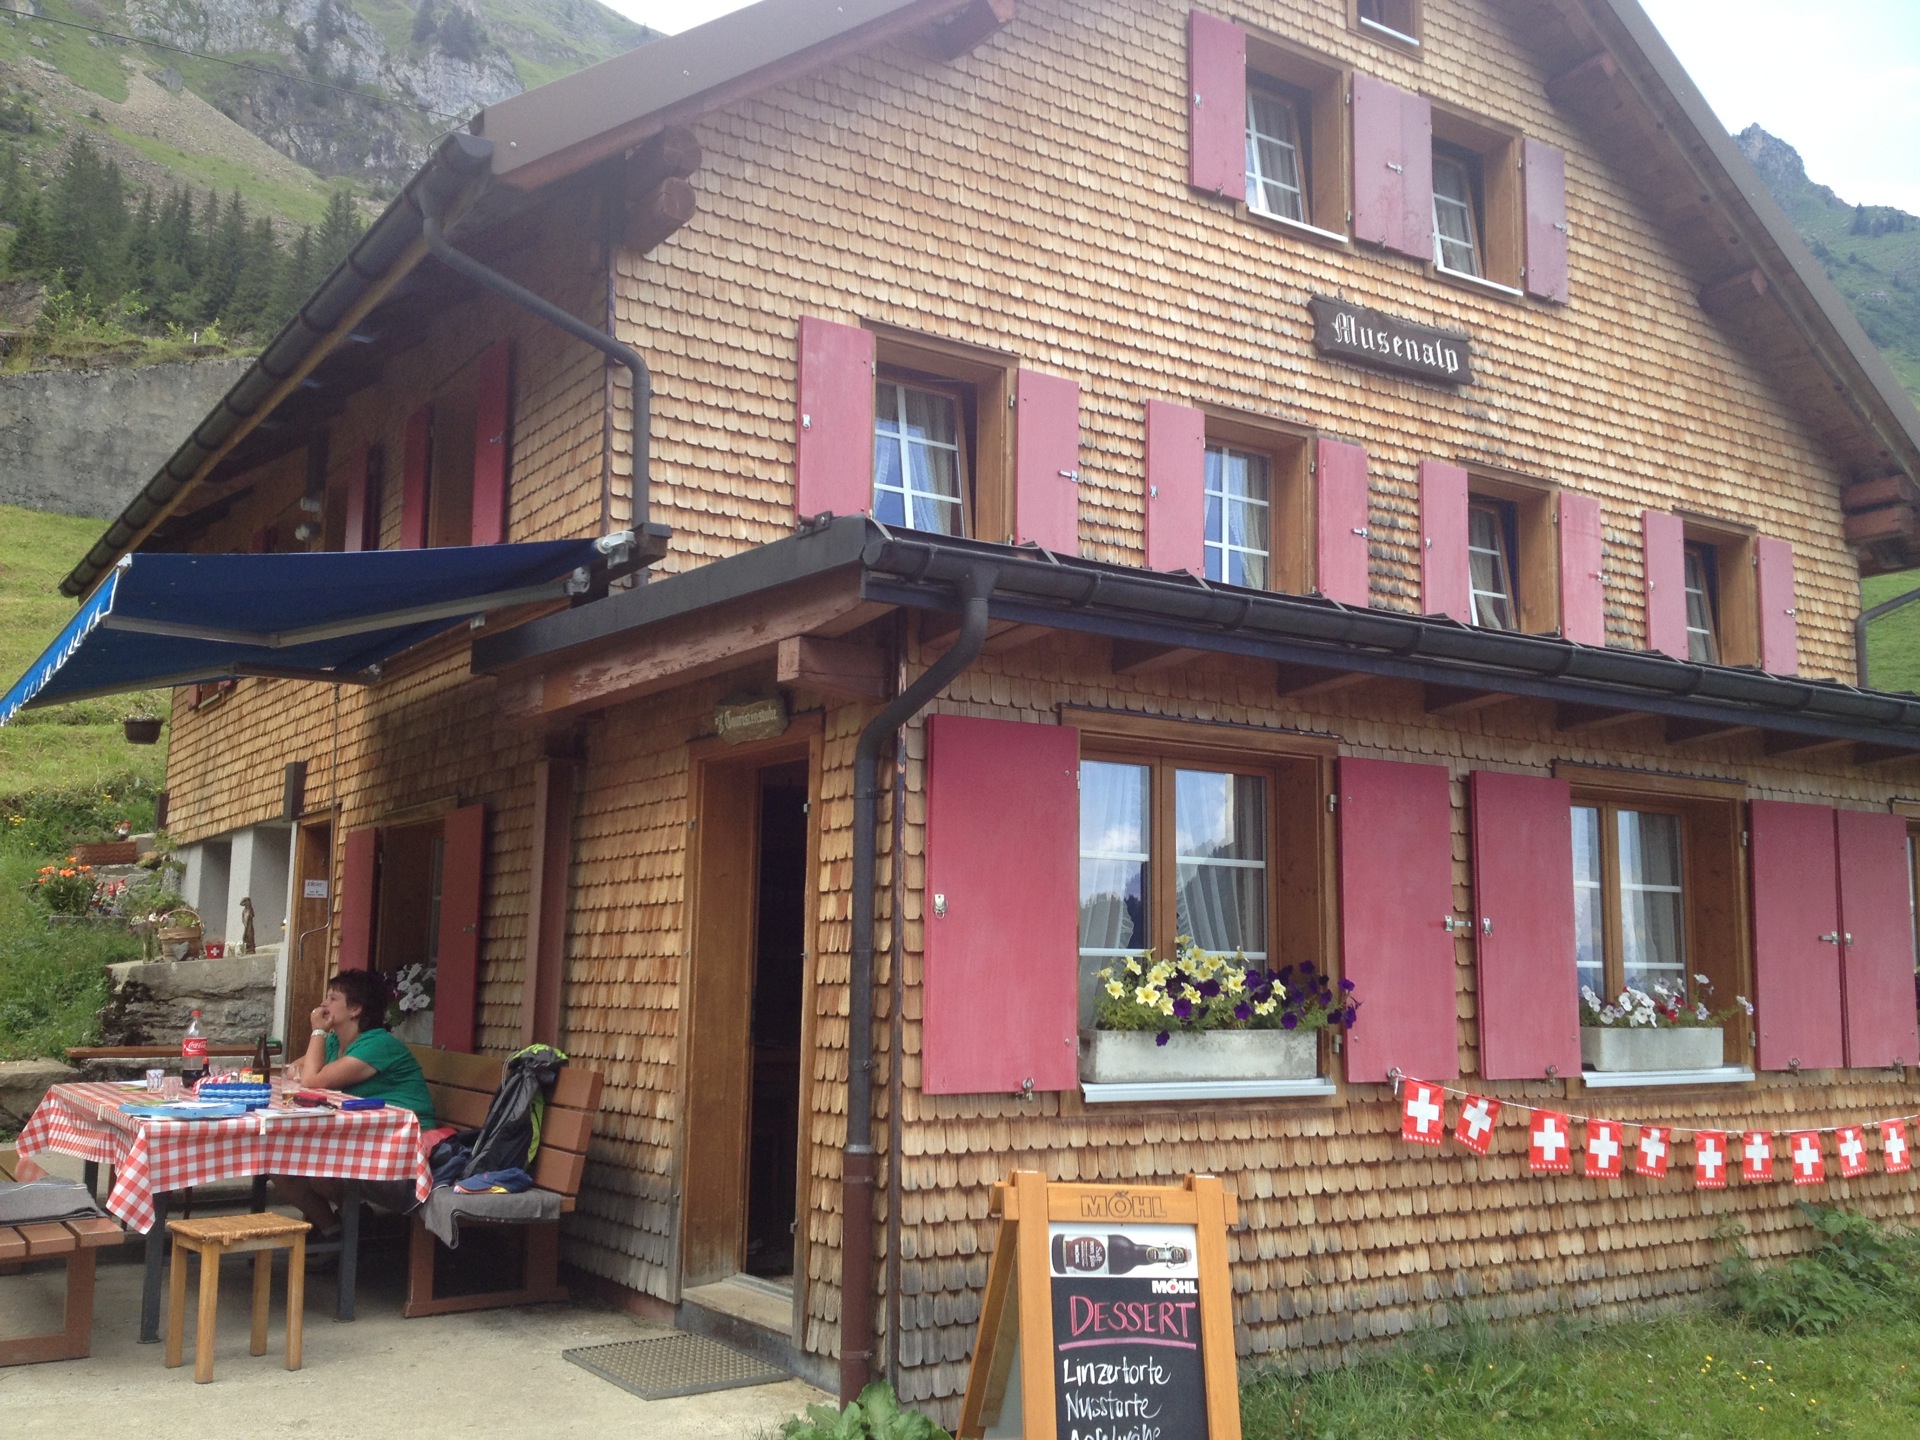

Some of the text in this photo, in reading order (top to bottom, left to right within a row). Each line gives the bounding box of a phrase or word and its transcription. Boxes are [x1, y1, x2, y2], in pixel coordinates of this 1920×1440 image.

[1331, 312, 1460, 375] Musenalp
[1080, 1190, 1168, 1219] MÖHL
[1151, 1278, 1198, 1294] MÖHL
[1070, 1295, 1197, 1338] DESSERT
[1063, 1355, 1172, 1387] Linzertorte
[1065, 1389, 1163, 1422] Nusstorte
